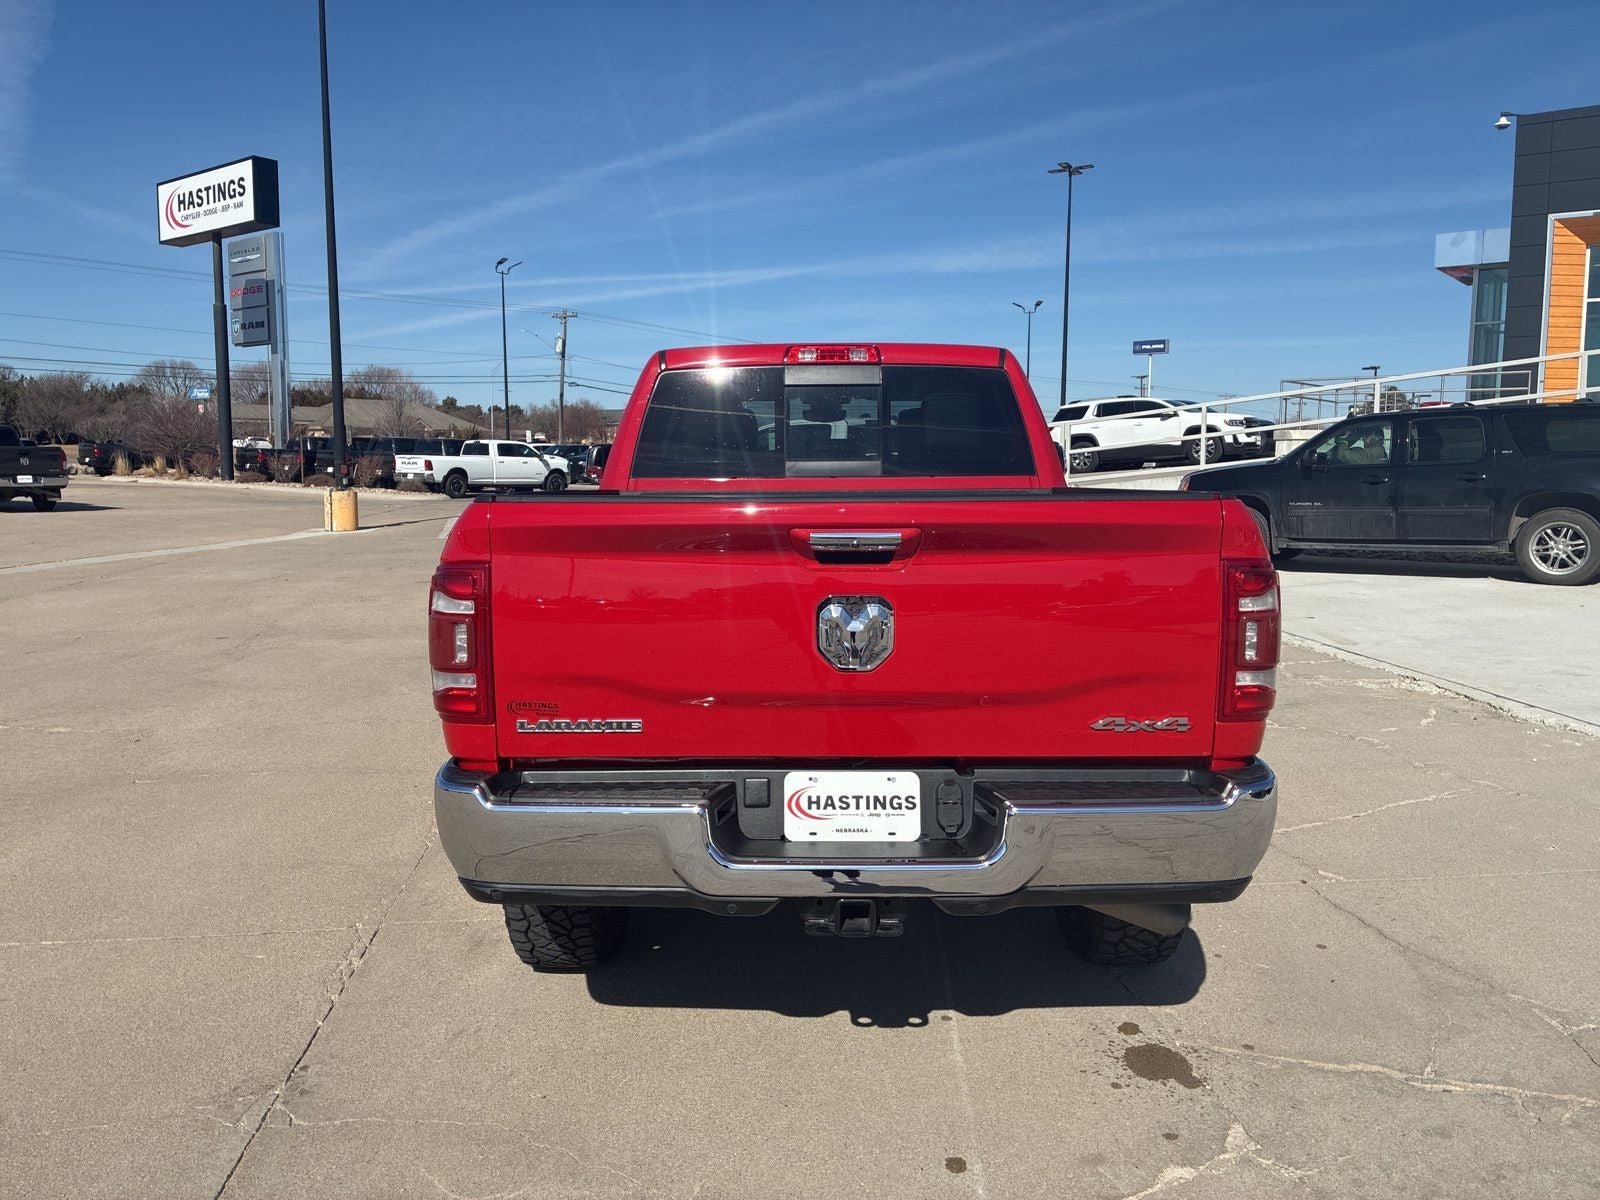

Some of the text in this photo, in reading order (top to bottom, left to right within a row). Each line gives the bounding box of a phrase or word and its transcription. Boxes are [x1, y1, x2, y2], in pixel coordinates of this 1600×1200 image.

[177, 176, 247, 213] HASTINGS
[180, 200, 244, 223] CHRYSLER DODGE JEEP RAM
[230, 285, 263, 297] DODGE
[240, 320, 265, 331] RAM
[515, 701, 560, 709] HASTINGS
[516, 719, 643, 733] LARAMIE
[1089, 716, 1193, 733] 4x4
[807, 795, 917, 811] HASTINGS
